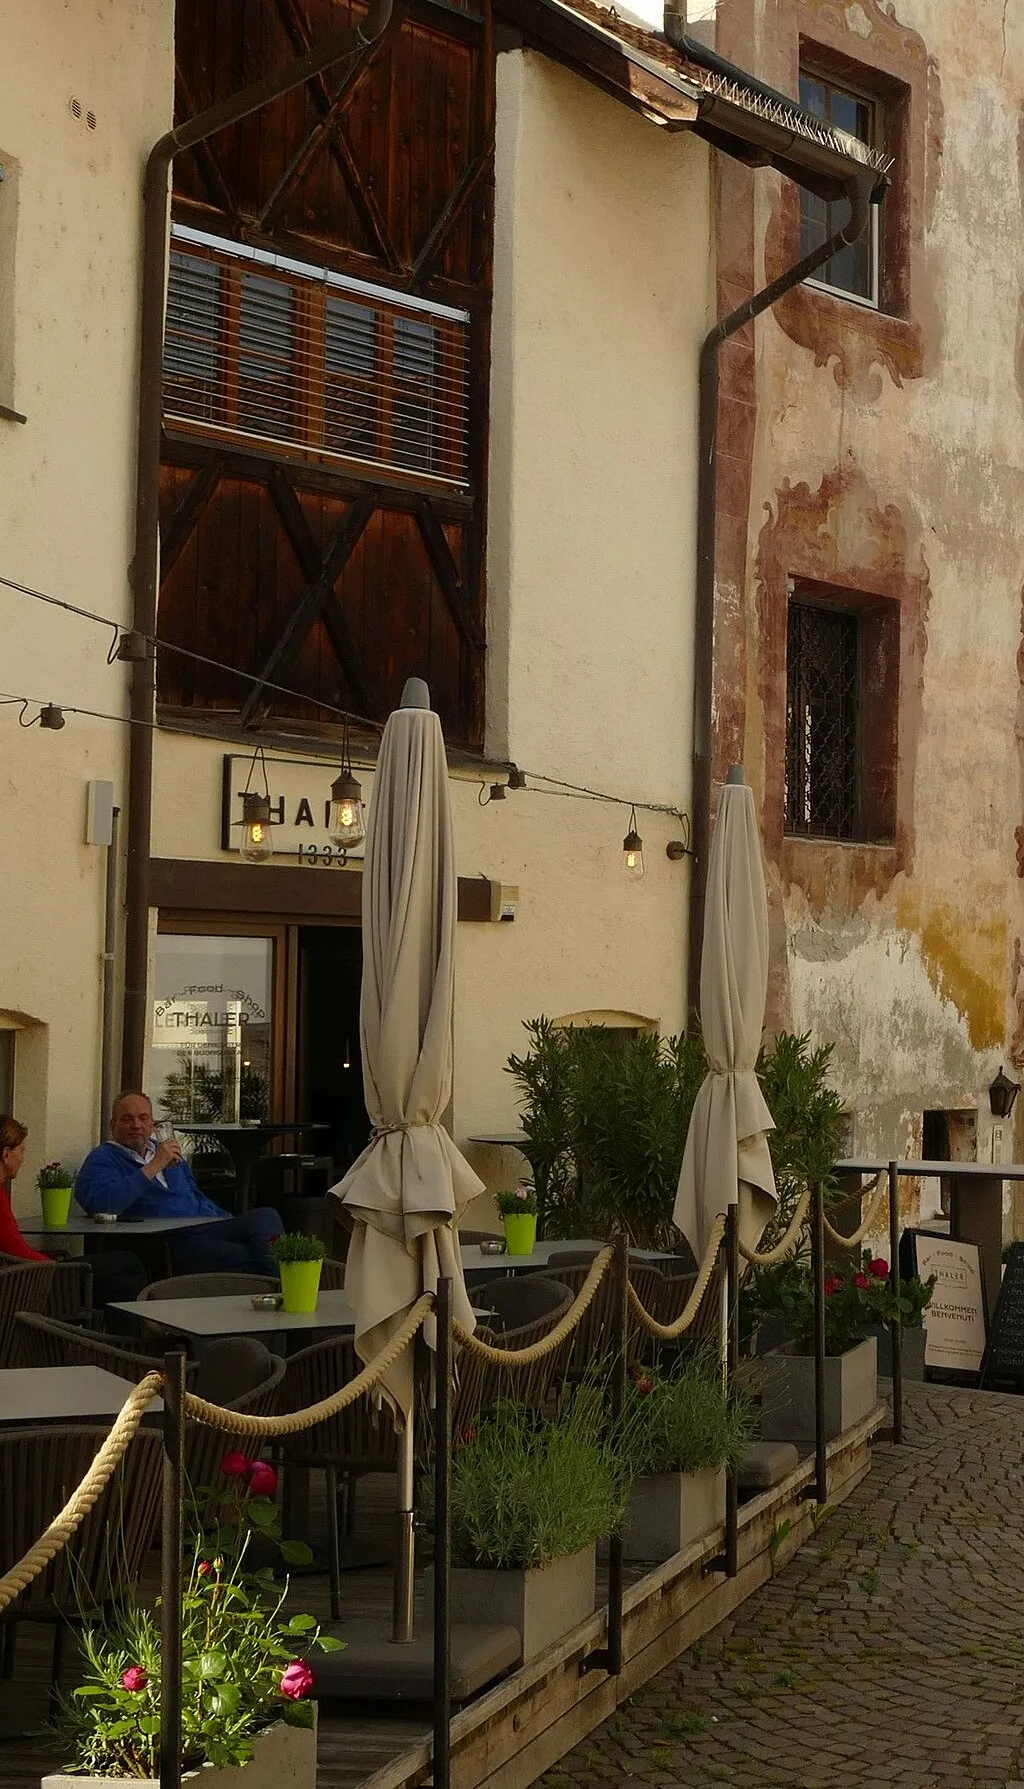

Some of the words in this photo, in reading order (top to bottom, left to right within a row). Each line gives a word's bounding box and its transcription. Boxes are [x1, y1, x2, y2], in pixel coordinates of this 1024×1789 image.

[298, 843, 348, 867] 1333
[155, 995, 176, 1017] Bar
[187, 984, 224, 995] Food
[234, 990, 266, 1019] Shop
[171, 1012, 250, 1027] THALER
[931, 1310, 975, 1322] BENVENUTI
